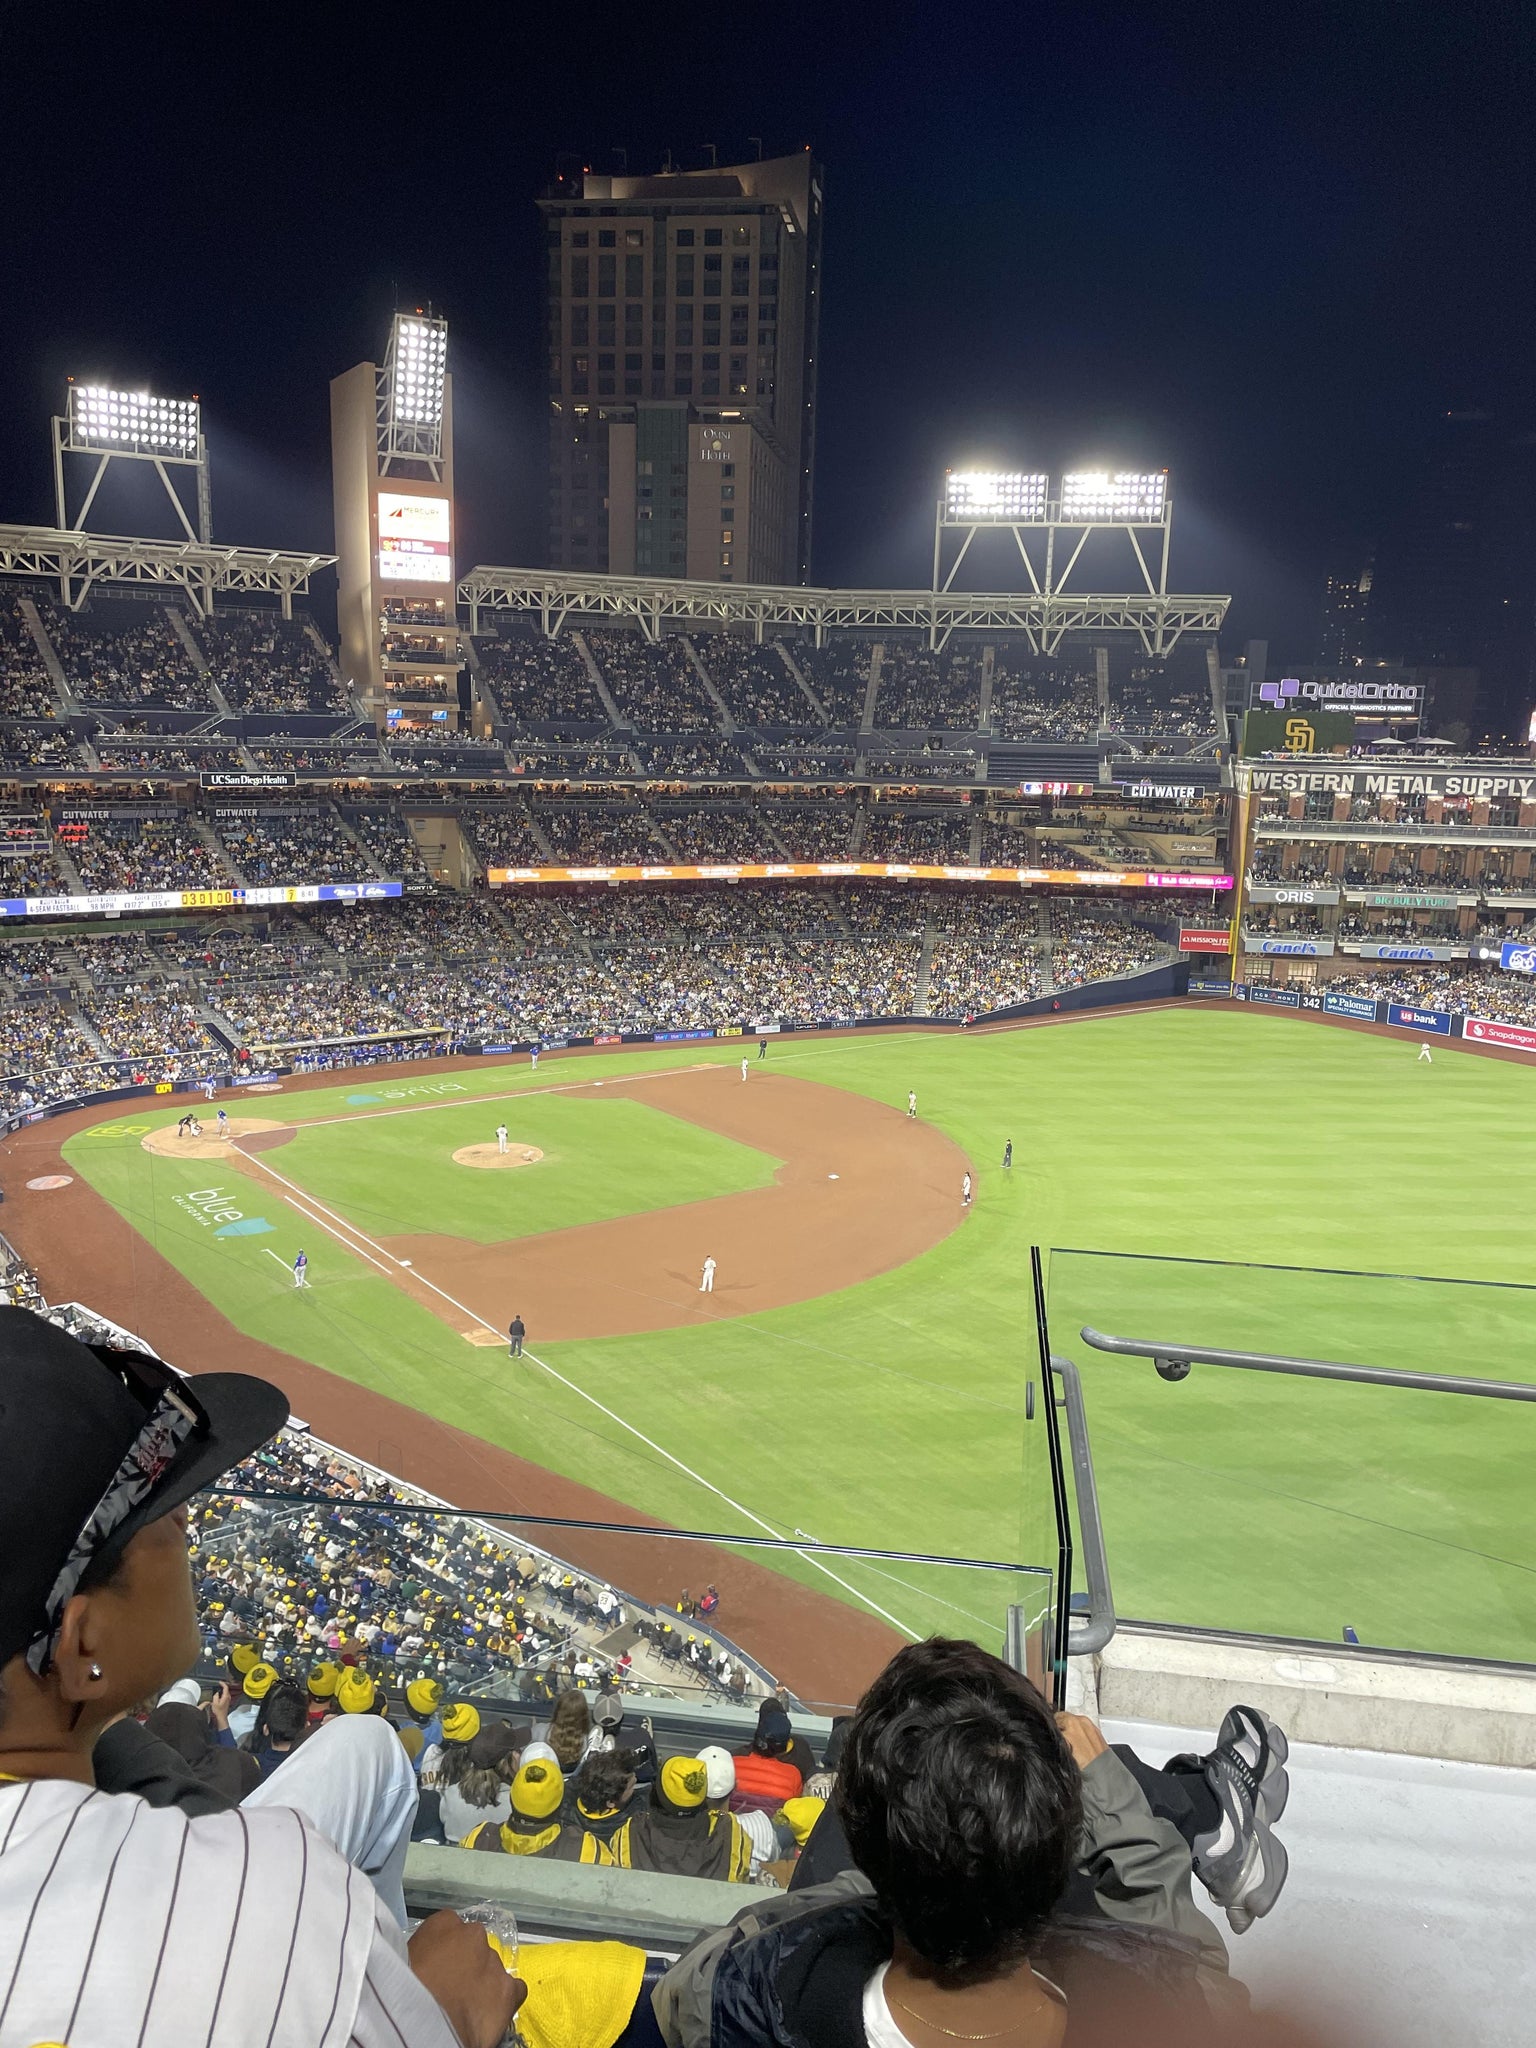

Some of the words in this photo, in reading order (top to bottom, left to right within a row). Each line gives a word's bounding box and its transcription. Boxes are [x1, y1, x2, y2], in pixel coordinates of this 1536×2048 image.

[1303, 682, 1417, 701] QuidelOrtho
[211, 775, 225, 784] UC
[224, 775, 240, 784] San
[240, 775, 262, 786] Diego
[263, 775, 287, 785] Health
[1252, 772, 1355, 792] WESTERN
[1365, 775, 1438, 794] METAL
[1446, 777, 1534, 797] SUPPLY
[1131, 785, 1195, 798] CUTWATER
[62, 810, 109, 819] CUTWATER
[216, 808, 257, 817] CUTWATER
[1275, 890, 1314, 903] ORIS
[1375, 896, 1392, 905] BIG
[1393, 896, 1422, 906] BULLY
[100, 902, 114, 910] MPH
[1302, 996, 1320, 1009] 342
[1339, 997, 1374, 1012] Palomar
[1488, 1028, 1536, 1044] Snapdragon
[235, 1076, 270, 1085] Southwest
[171, 1195, 211, 1227] CALIFORNIA
[185, 1187, 243, 1222] blue
